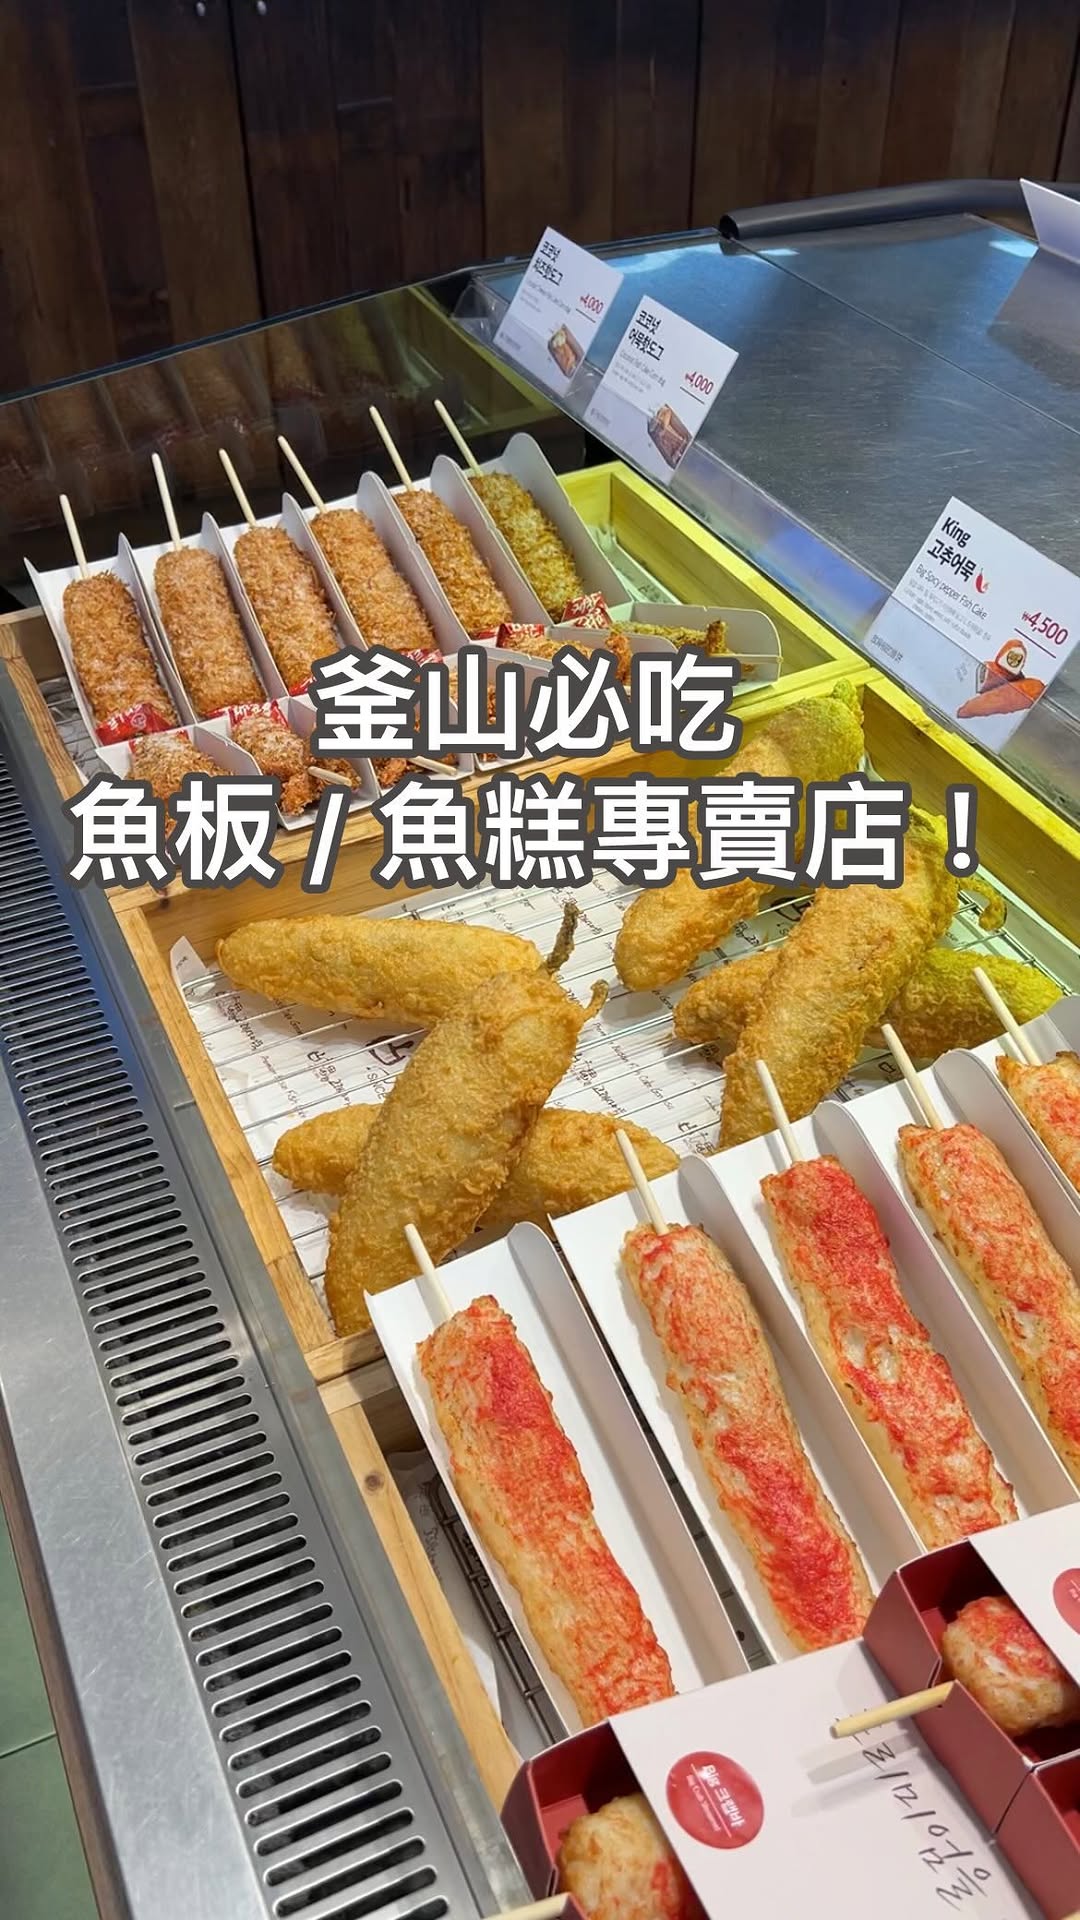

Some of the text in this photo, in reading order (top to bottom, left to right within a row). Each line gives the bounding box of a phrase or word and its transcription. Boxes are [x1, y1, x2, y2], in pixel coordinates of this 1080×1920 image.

[539, 240, 562, 264] 코코넛
[635, 310, 662, 334] 코코넛
[628, 328, 665, 361] 어묵핫도그
[941, 516, 971, 548] King
[927, 538, 977, 582] 고추어묵
[915, 564, 988, 620] Big Spicy pepper Fish Cake
[702, 1764, 720, 1787] Big
[714, 1787, 745, 1827] 크랩바
